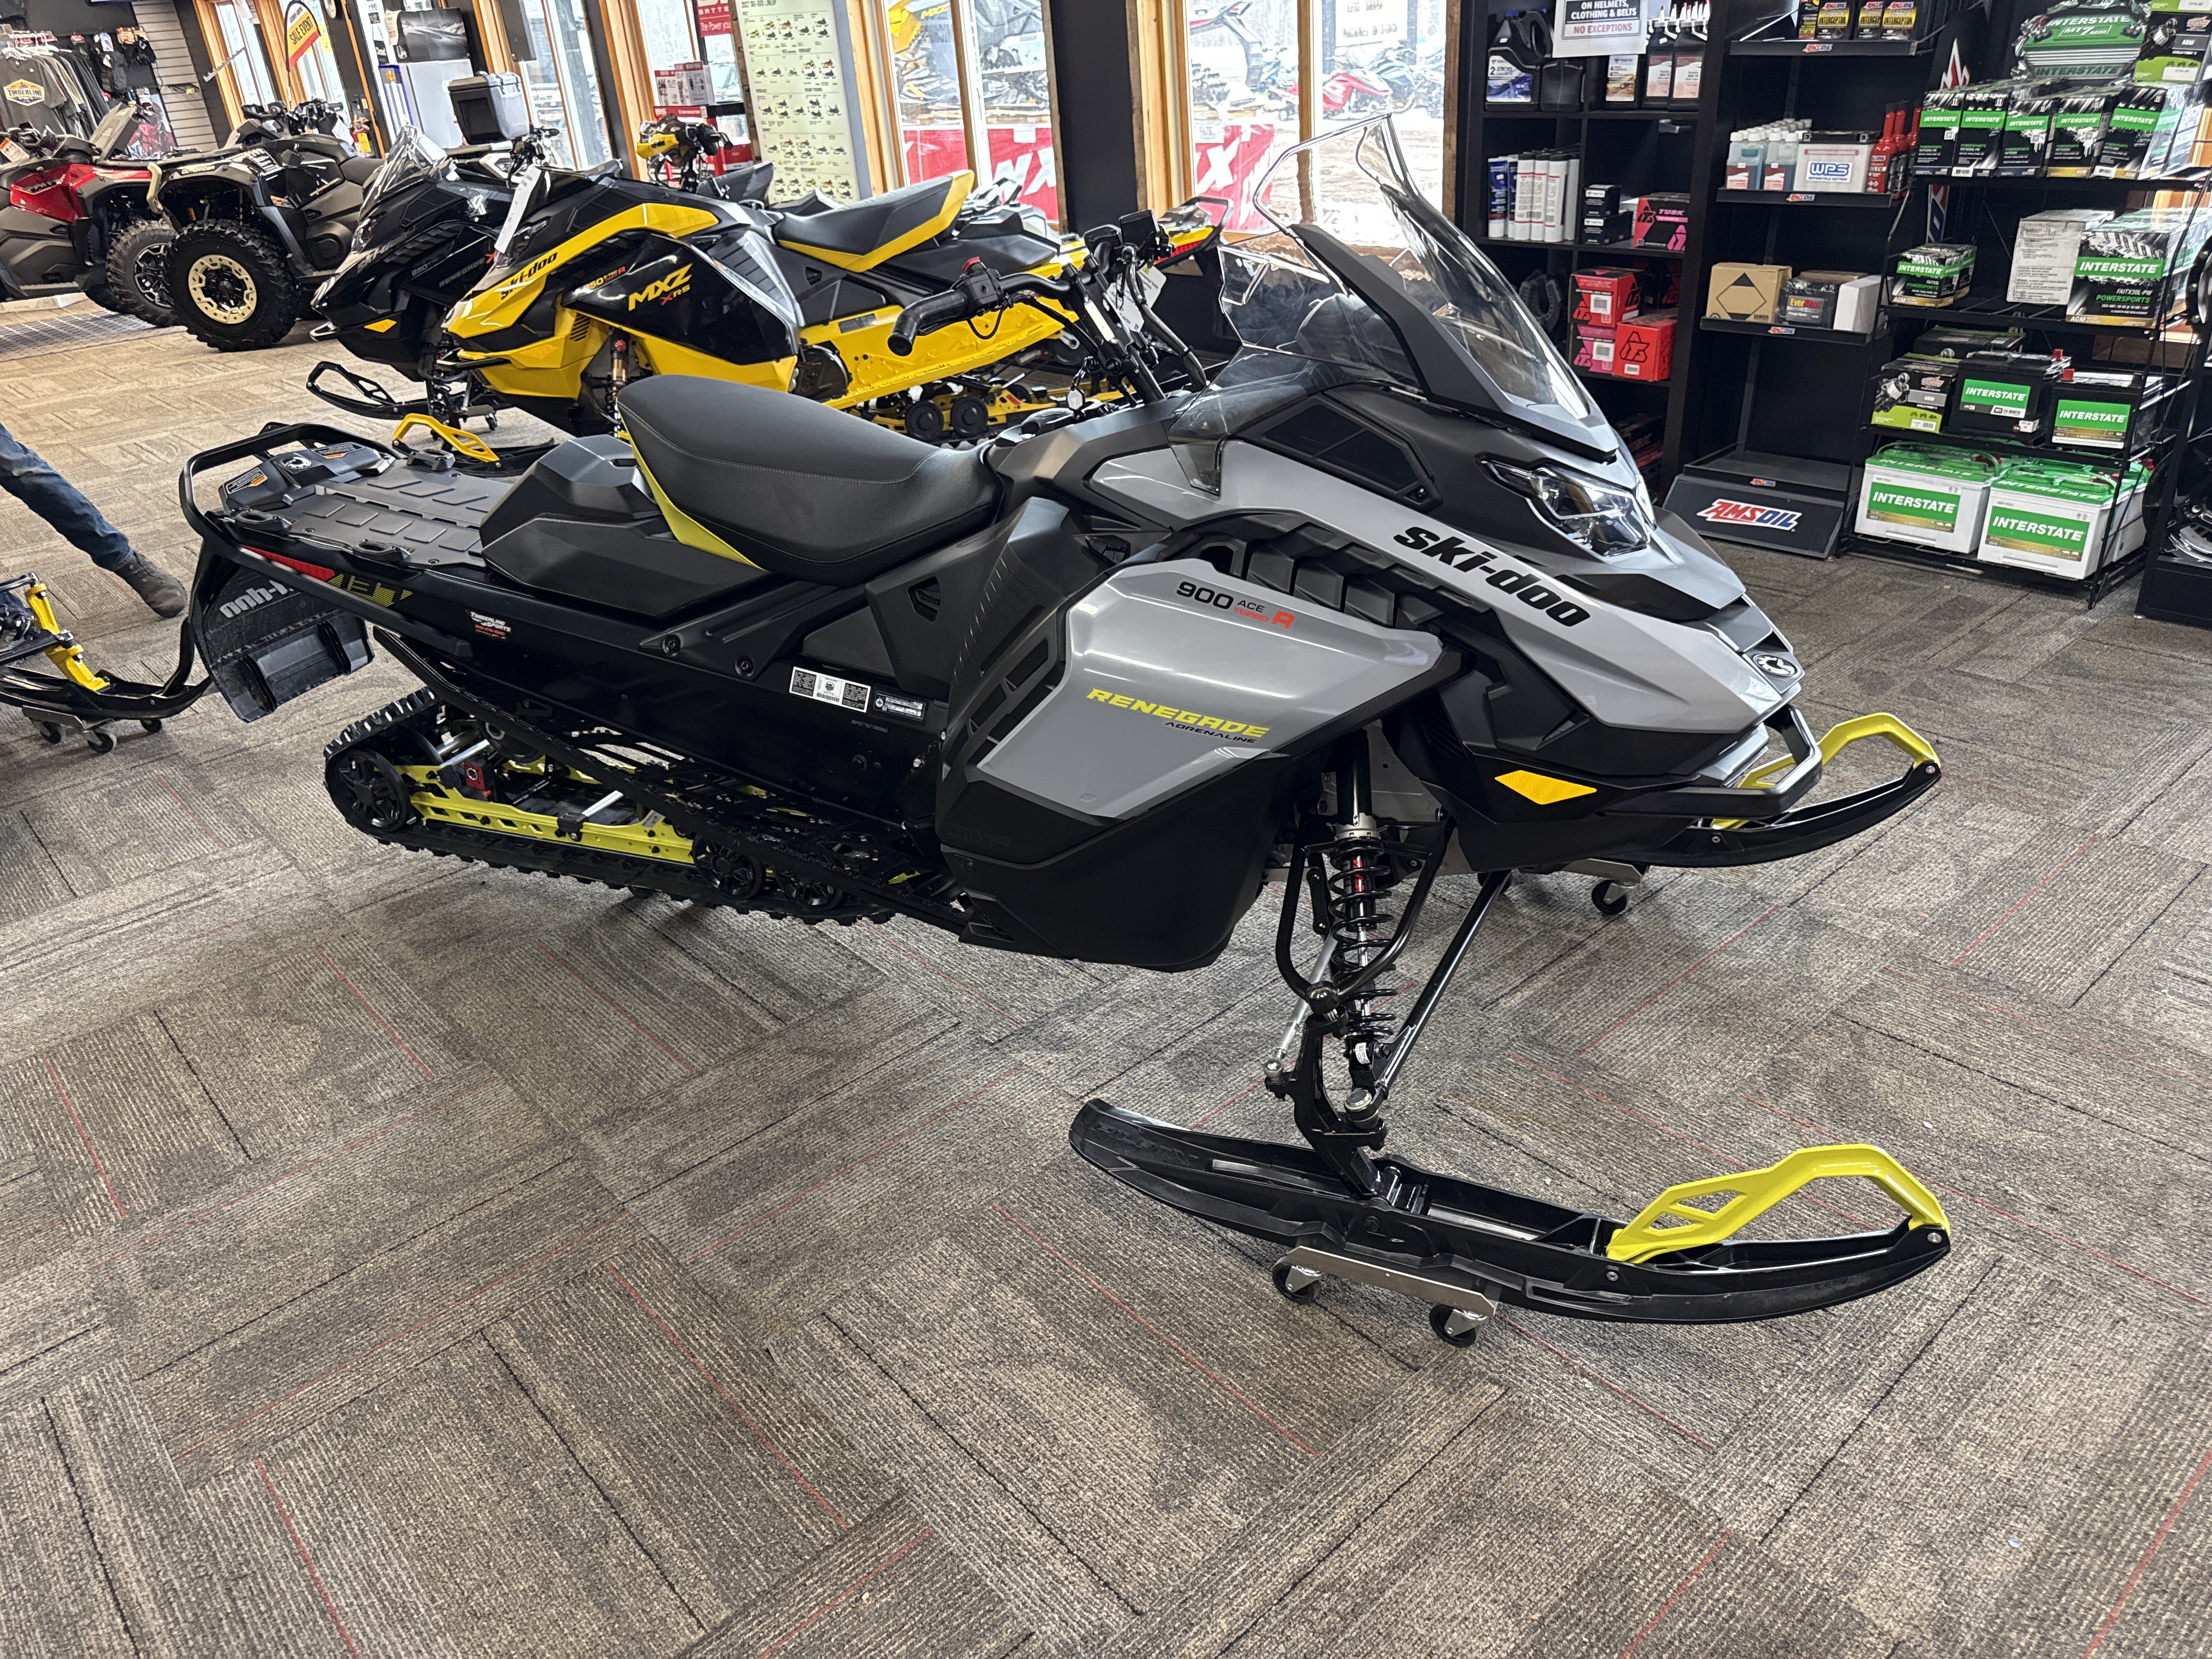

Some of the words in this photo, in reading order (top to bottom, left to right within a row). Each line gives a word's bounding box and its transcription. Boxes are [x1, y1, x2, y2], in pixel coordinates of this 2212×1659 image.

[1594, 0, 1629, 9] HELMETS,
[1571, 10, 1608, 20] CLOTHING
[1609, 9, 1616, 18] &
[1617, 8, 1637, 17] BELTS
[1884, 16, 1914, 25] INTERCEPTOR
[1573, 26, 1585, 34] NO
[1588, 23, 1633, 33] EXCEPTIONS
[2047, 16, 2130, 27] INTERSTATE
[289, 26, 303, 45] SALE
[300, 16, 314, 36] EVENT
[2035, 66, 2121, 76] INTERSTATE
[2113, 115, 2155, 125] INTERSTATE
[182, 165, 216, 174] OUTLANDER
[1810, 163, 1850, 177] WPS
[1899, 264, 1942, 275] INTERSTATE
[2079, 262, 2159, 274] INTERSTATE
[629, 263, 693, 312] MXZ
[2096, 295, 2151, 303] POWERSPORTS
[1965, 387, 2027, 401] INTERSTATE
[2059, 410, 2126, 423] INTERSTATE
[1879, 458, 1972, 476] INTERSTATE
[1997, 480, 2103, 499] INTERSTATE
[1872, 492, 1956, 514] INTERSTATE
[1703, 501, 1798, 528] AMSOIL
[1993, 516, 2084, 541] INTERSTATE
[1393, 526, 1590, 627] ski-doo
[1176, 581, 1234, 610] 900
[1237, 600, 1266, 613] ACE
[1271, 610, 1295, 629] R
[470, 611, 506, 626] TIMBERLINE
[1234, 606, 1269, 622] TURBO
[486, 622, 511, 632] SPORTS
[1087, 687, 1271, 738] RENEGADE
[1164, 721, 1257, 744] ADRENALINE
